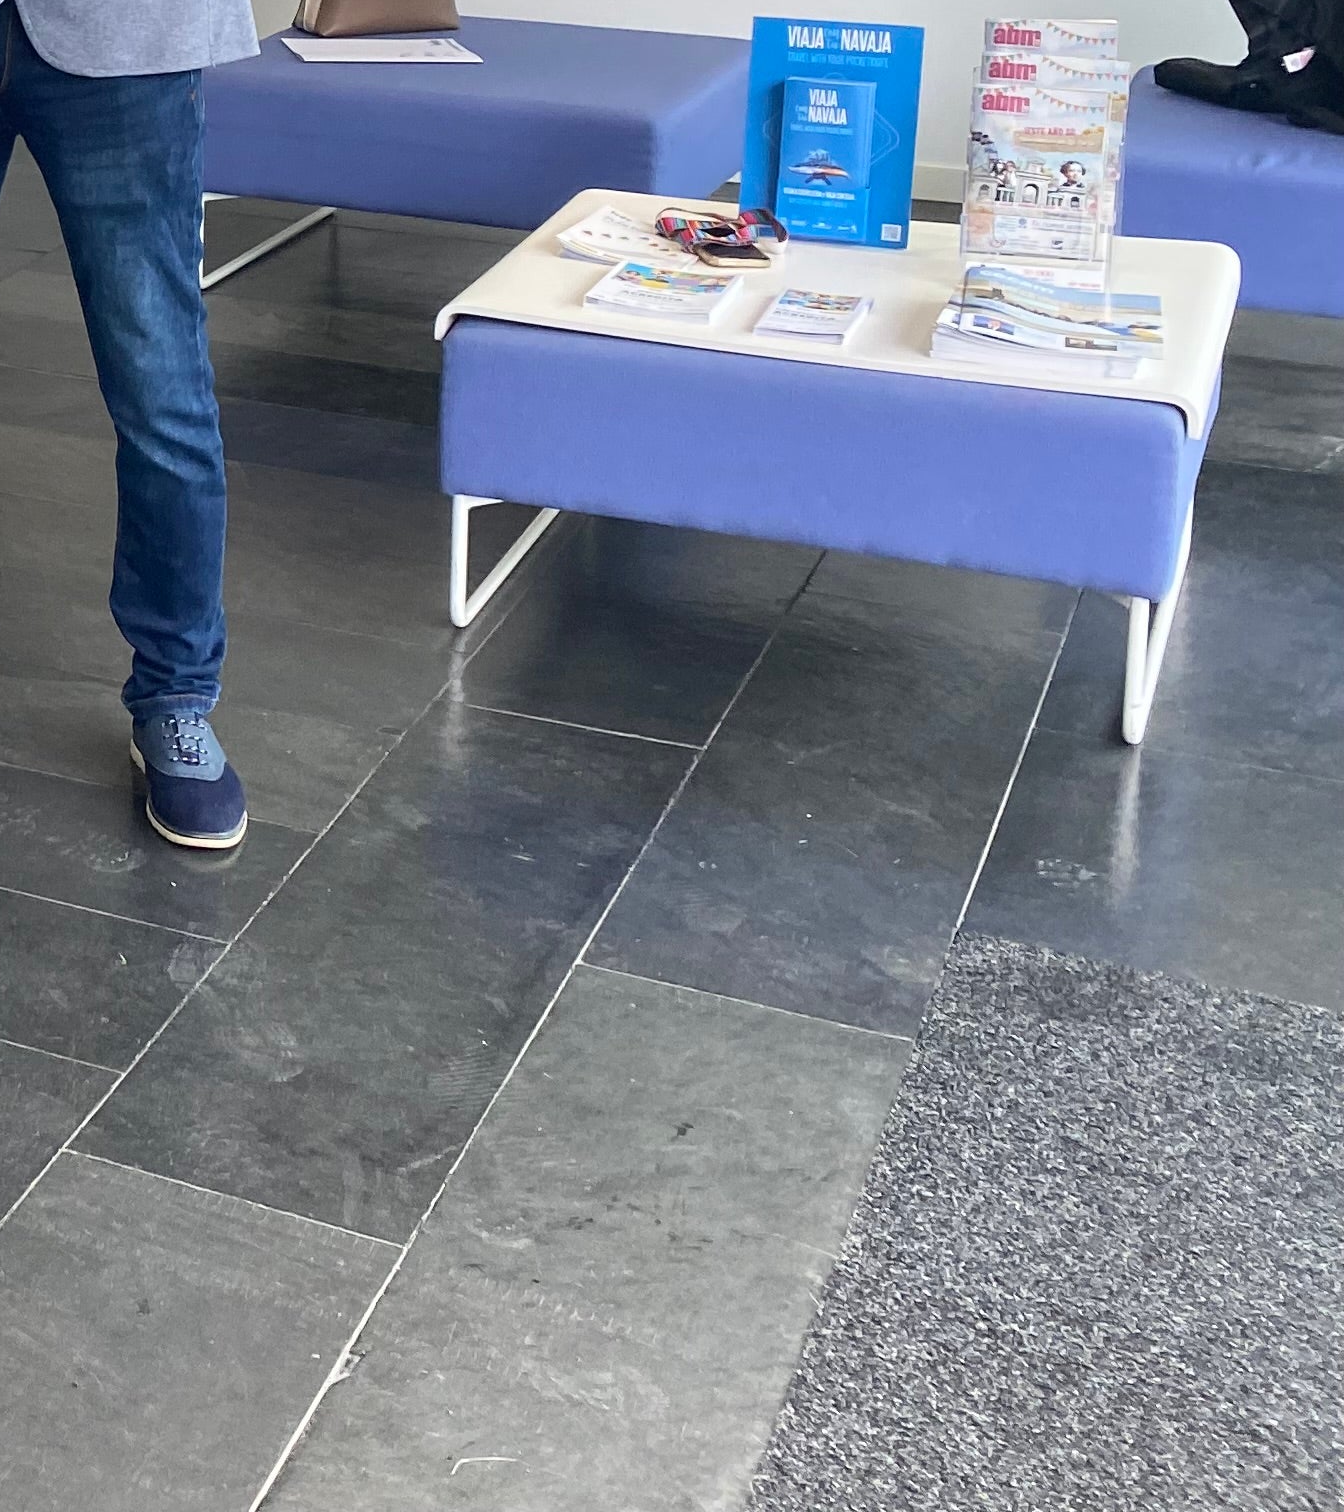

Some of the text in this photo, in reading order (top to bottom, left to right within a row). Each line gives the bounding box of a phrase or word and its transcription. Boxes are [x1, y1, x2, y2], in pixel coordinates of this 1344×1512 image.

[788, 26, 824, 49] VIAJA
[840, 29, 891, 53] NAVAJA
[809, 88, 838, 107] VIAJA
[808, 106, 847, 125] NAVAJA
